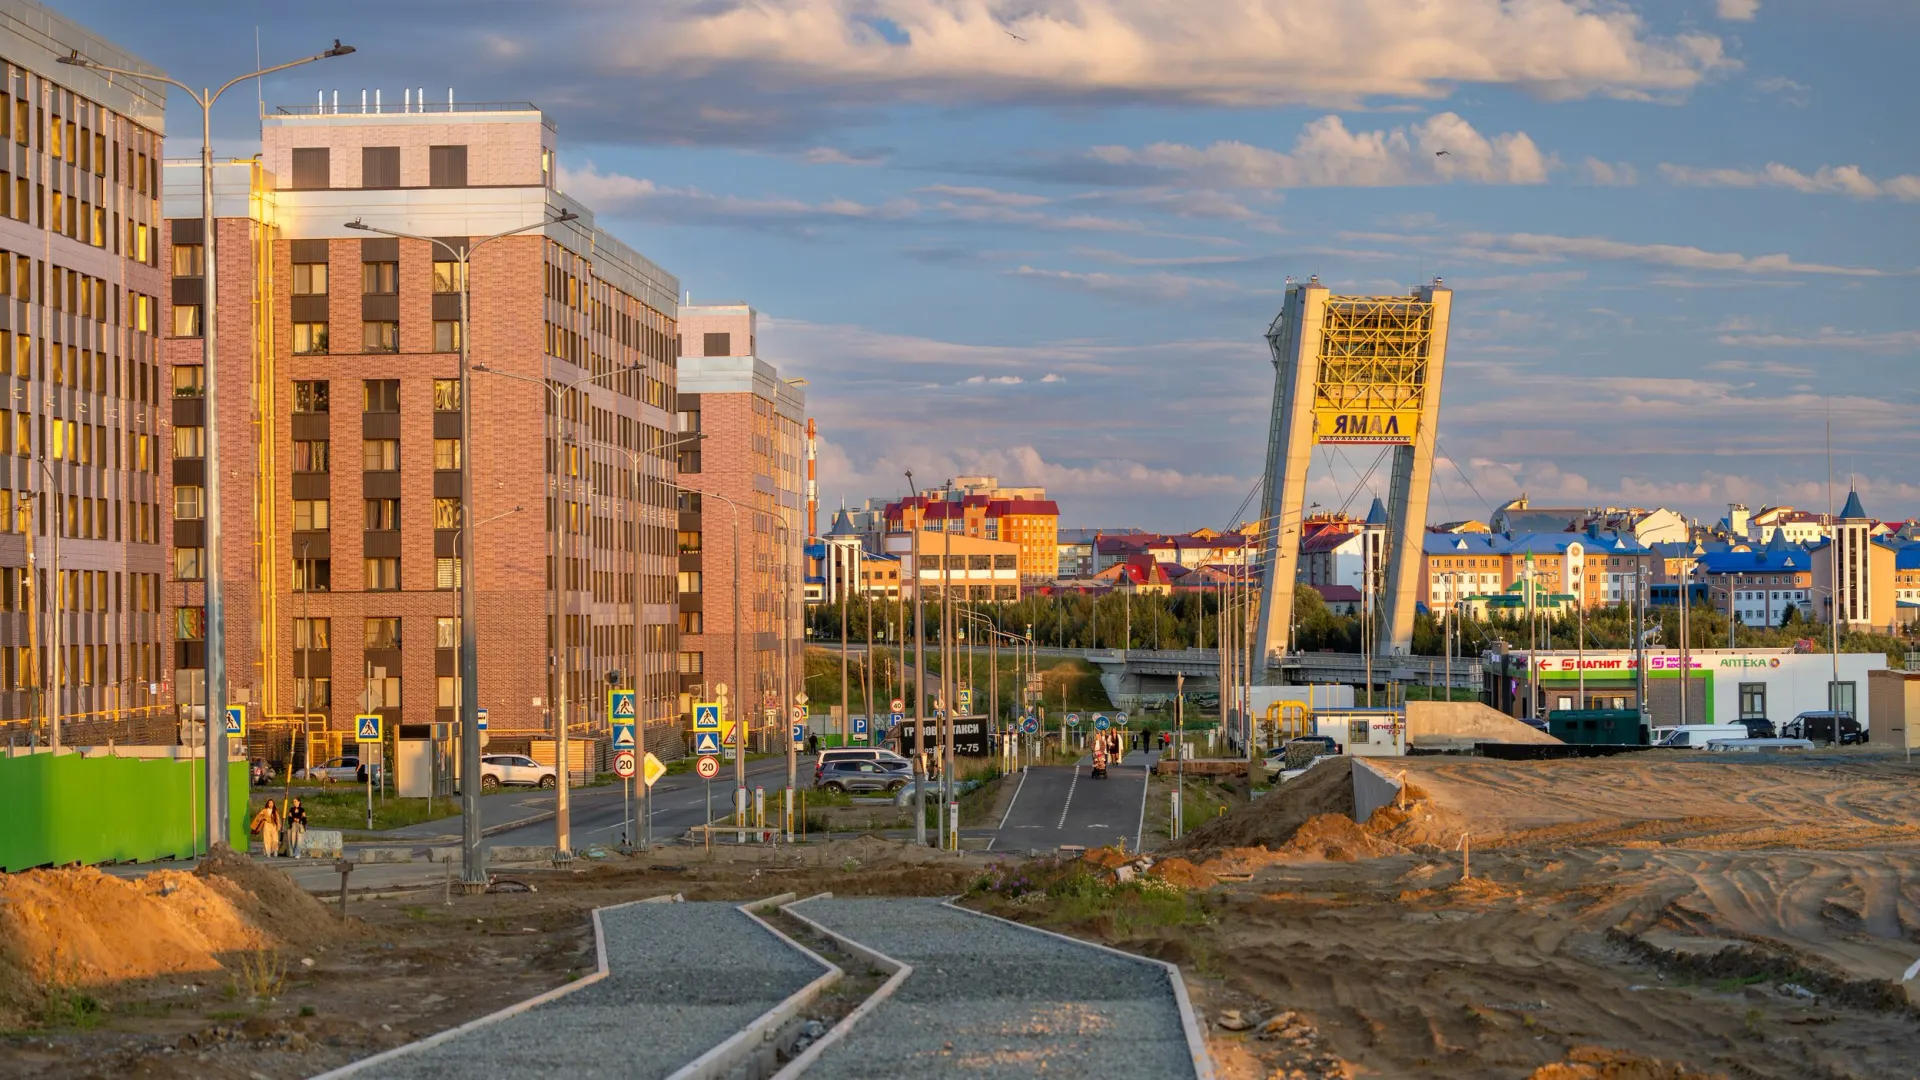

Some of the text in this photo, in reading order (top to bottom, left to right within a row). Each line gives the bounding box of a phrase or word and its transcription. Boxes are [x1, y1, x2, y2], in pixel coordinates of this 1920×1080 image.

[1333, 415, 1399, 434] ЯМАЛ
[1720, 659, 1767, 668] АПТЕКА
[619, 760, 632, 770] 20
[702, 763, 714, 771] 20
